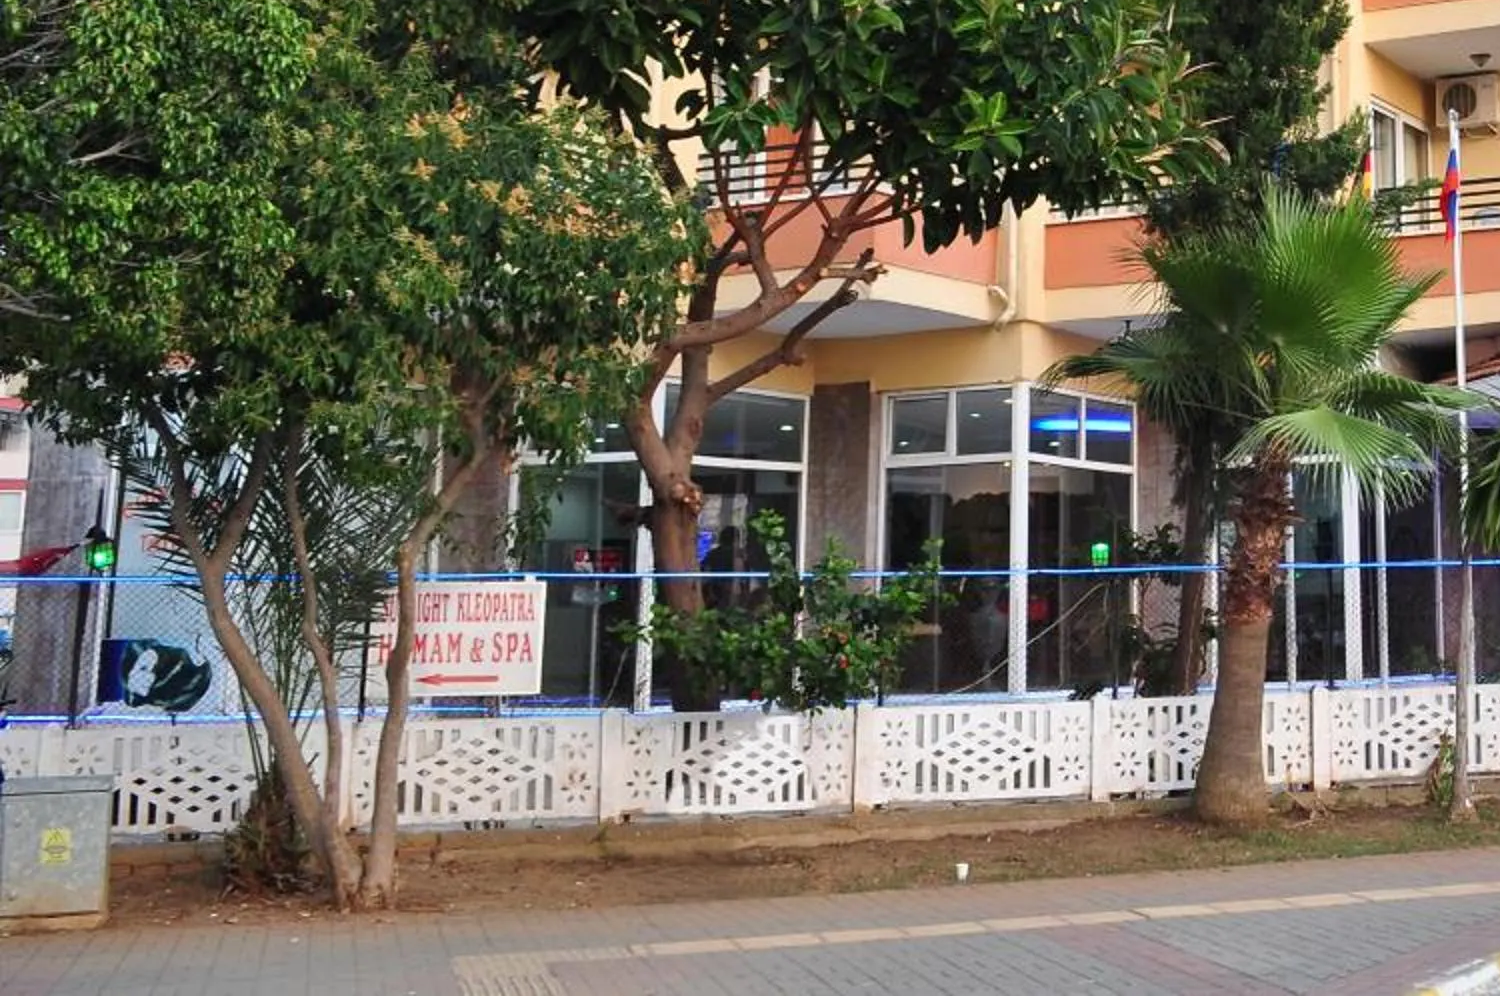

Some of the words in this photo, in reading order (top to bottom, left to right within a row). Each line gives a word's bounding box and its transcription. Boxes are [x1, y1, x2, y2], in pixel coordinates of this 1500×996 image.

[383, 592, 449, 622] SUIGHT
[456, 592, 536, 621] KLEOPATRA
[378, 632, 463, 664] HMAM
[470, 636, 485, 663] &
[491, 631, 534, 663] SPA
